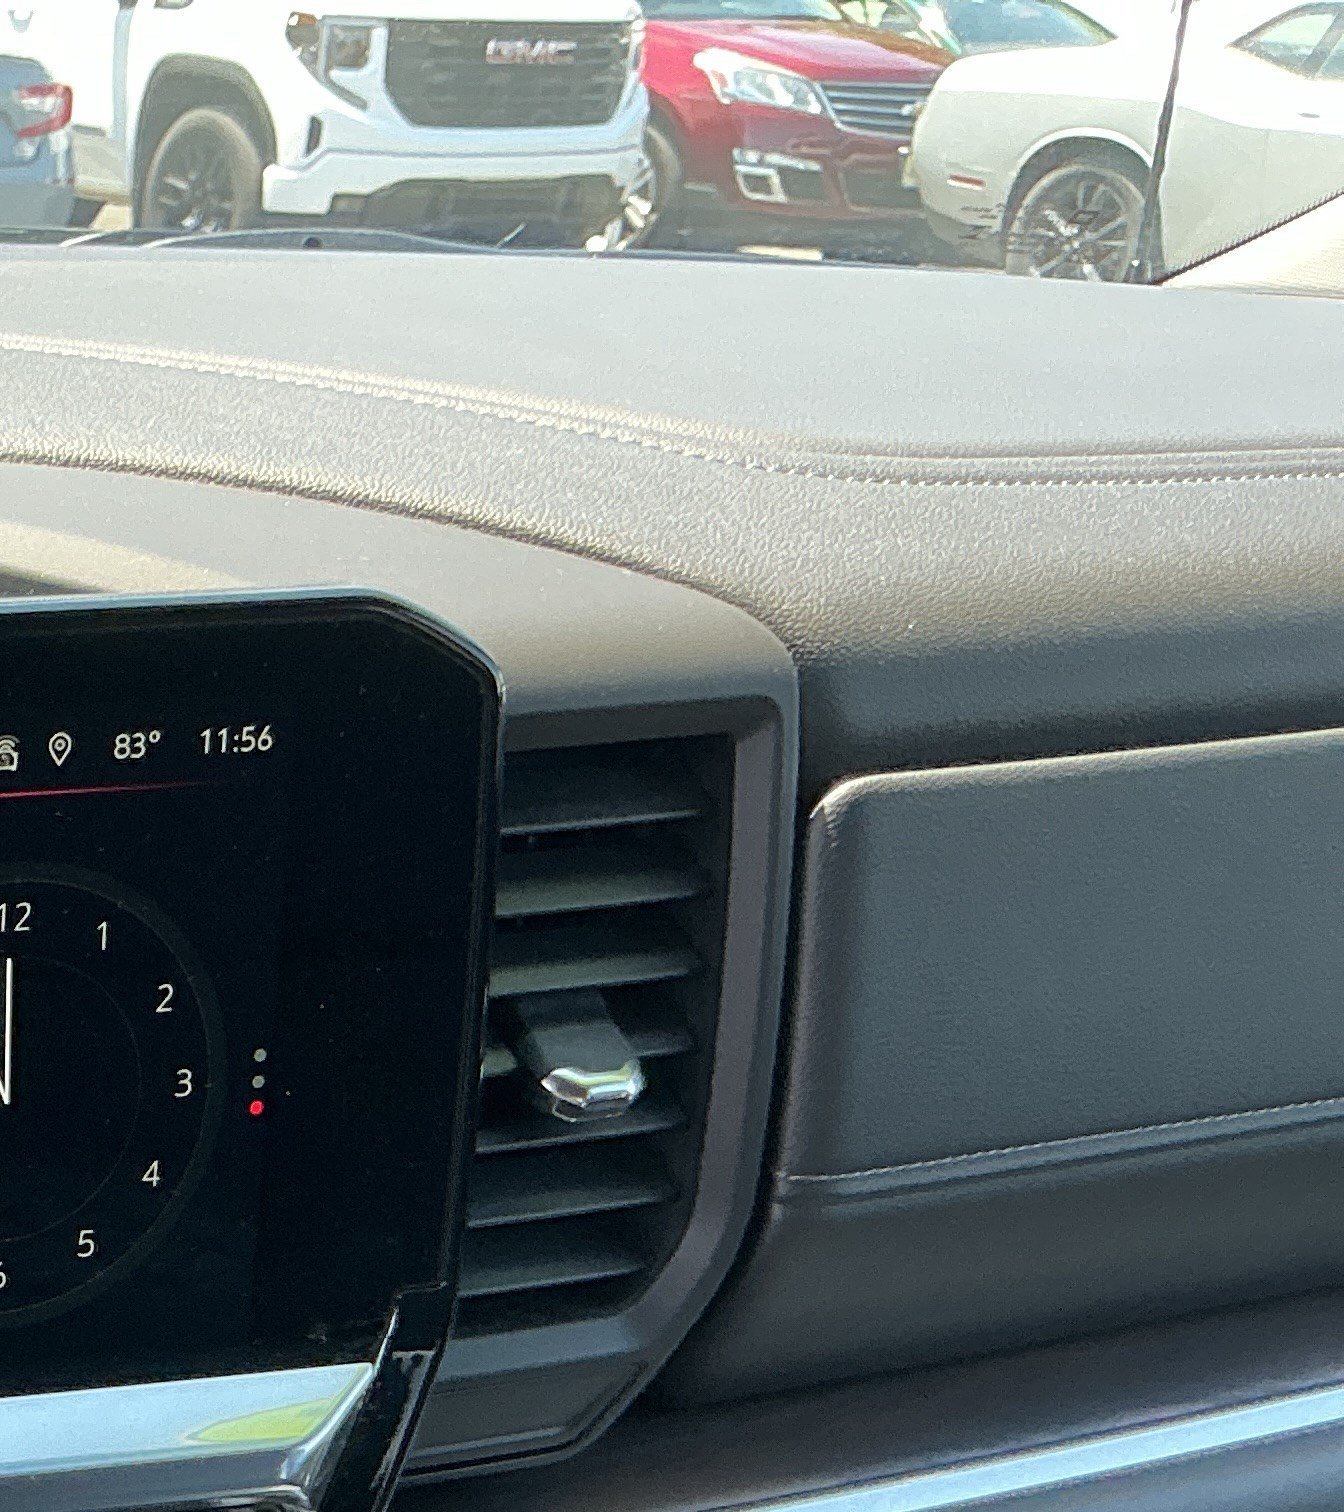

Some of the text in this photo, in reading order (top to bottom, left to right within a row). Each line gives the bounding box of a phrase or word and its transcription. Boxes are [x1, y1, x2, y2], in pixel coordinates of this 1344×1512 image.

[200, 725, 273, 754] 11:56
[97, 921, 108, 951] 1
[155, 983, 175, 1013] 2
[175, 1068, 193, 1098] 3
[142, 1160, 161, 1187] 4
[76, 1229, 95, 1258] 5
